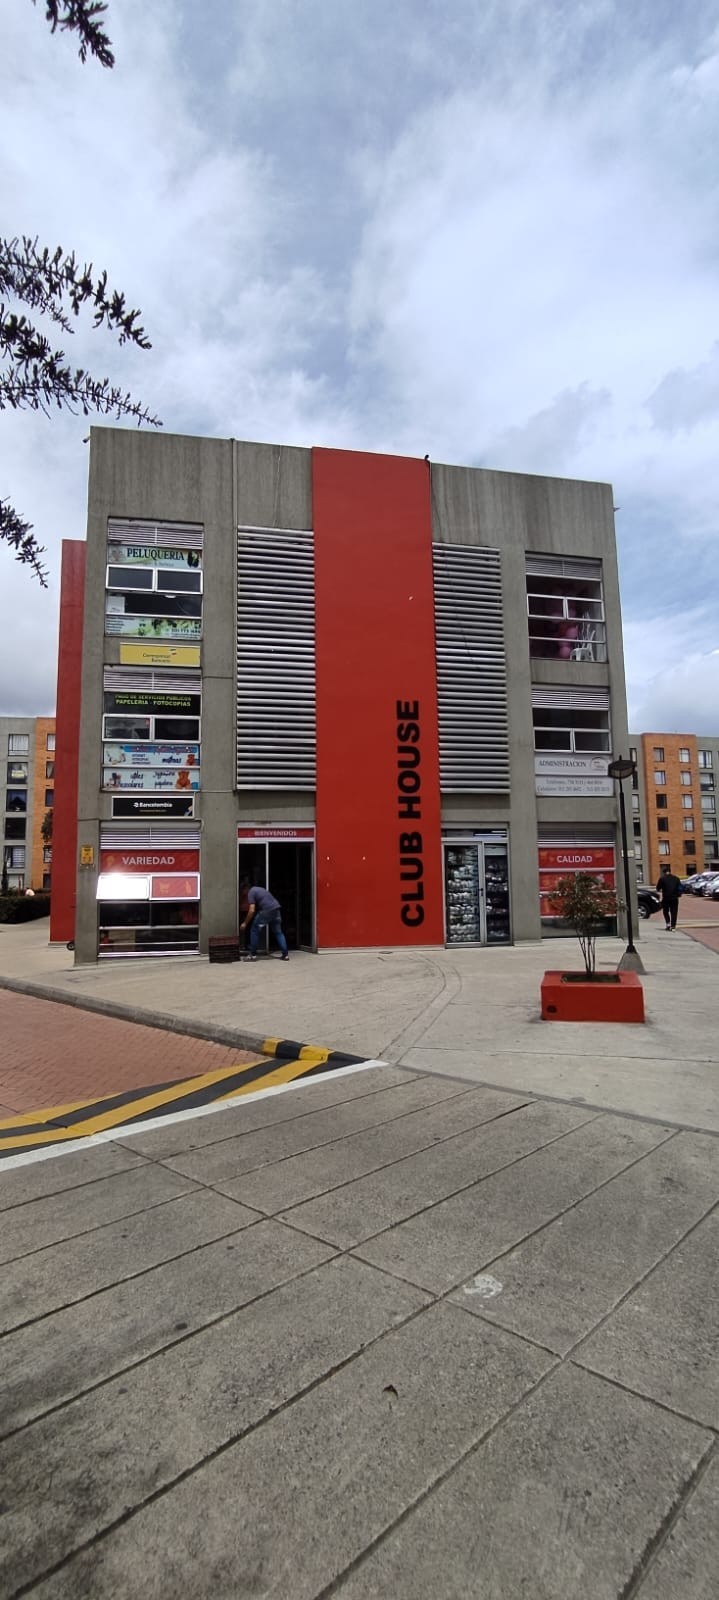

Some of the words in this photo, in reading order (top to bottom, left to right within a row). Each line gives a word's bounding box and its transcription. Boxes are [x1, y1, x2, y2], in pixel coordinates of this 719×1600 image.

[126, 547, 185, 561] PELUQUERIA
[396, 700, 421, 819] HOUSE
[539, 760, 587, 768] ADMINISTRACION
[121, 856, 176, 865] VARIEDAD
[556, 855, 593, 864] CALIDAD
[400, 831, 425, 927] CLUB
